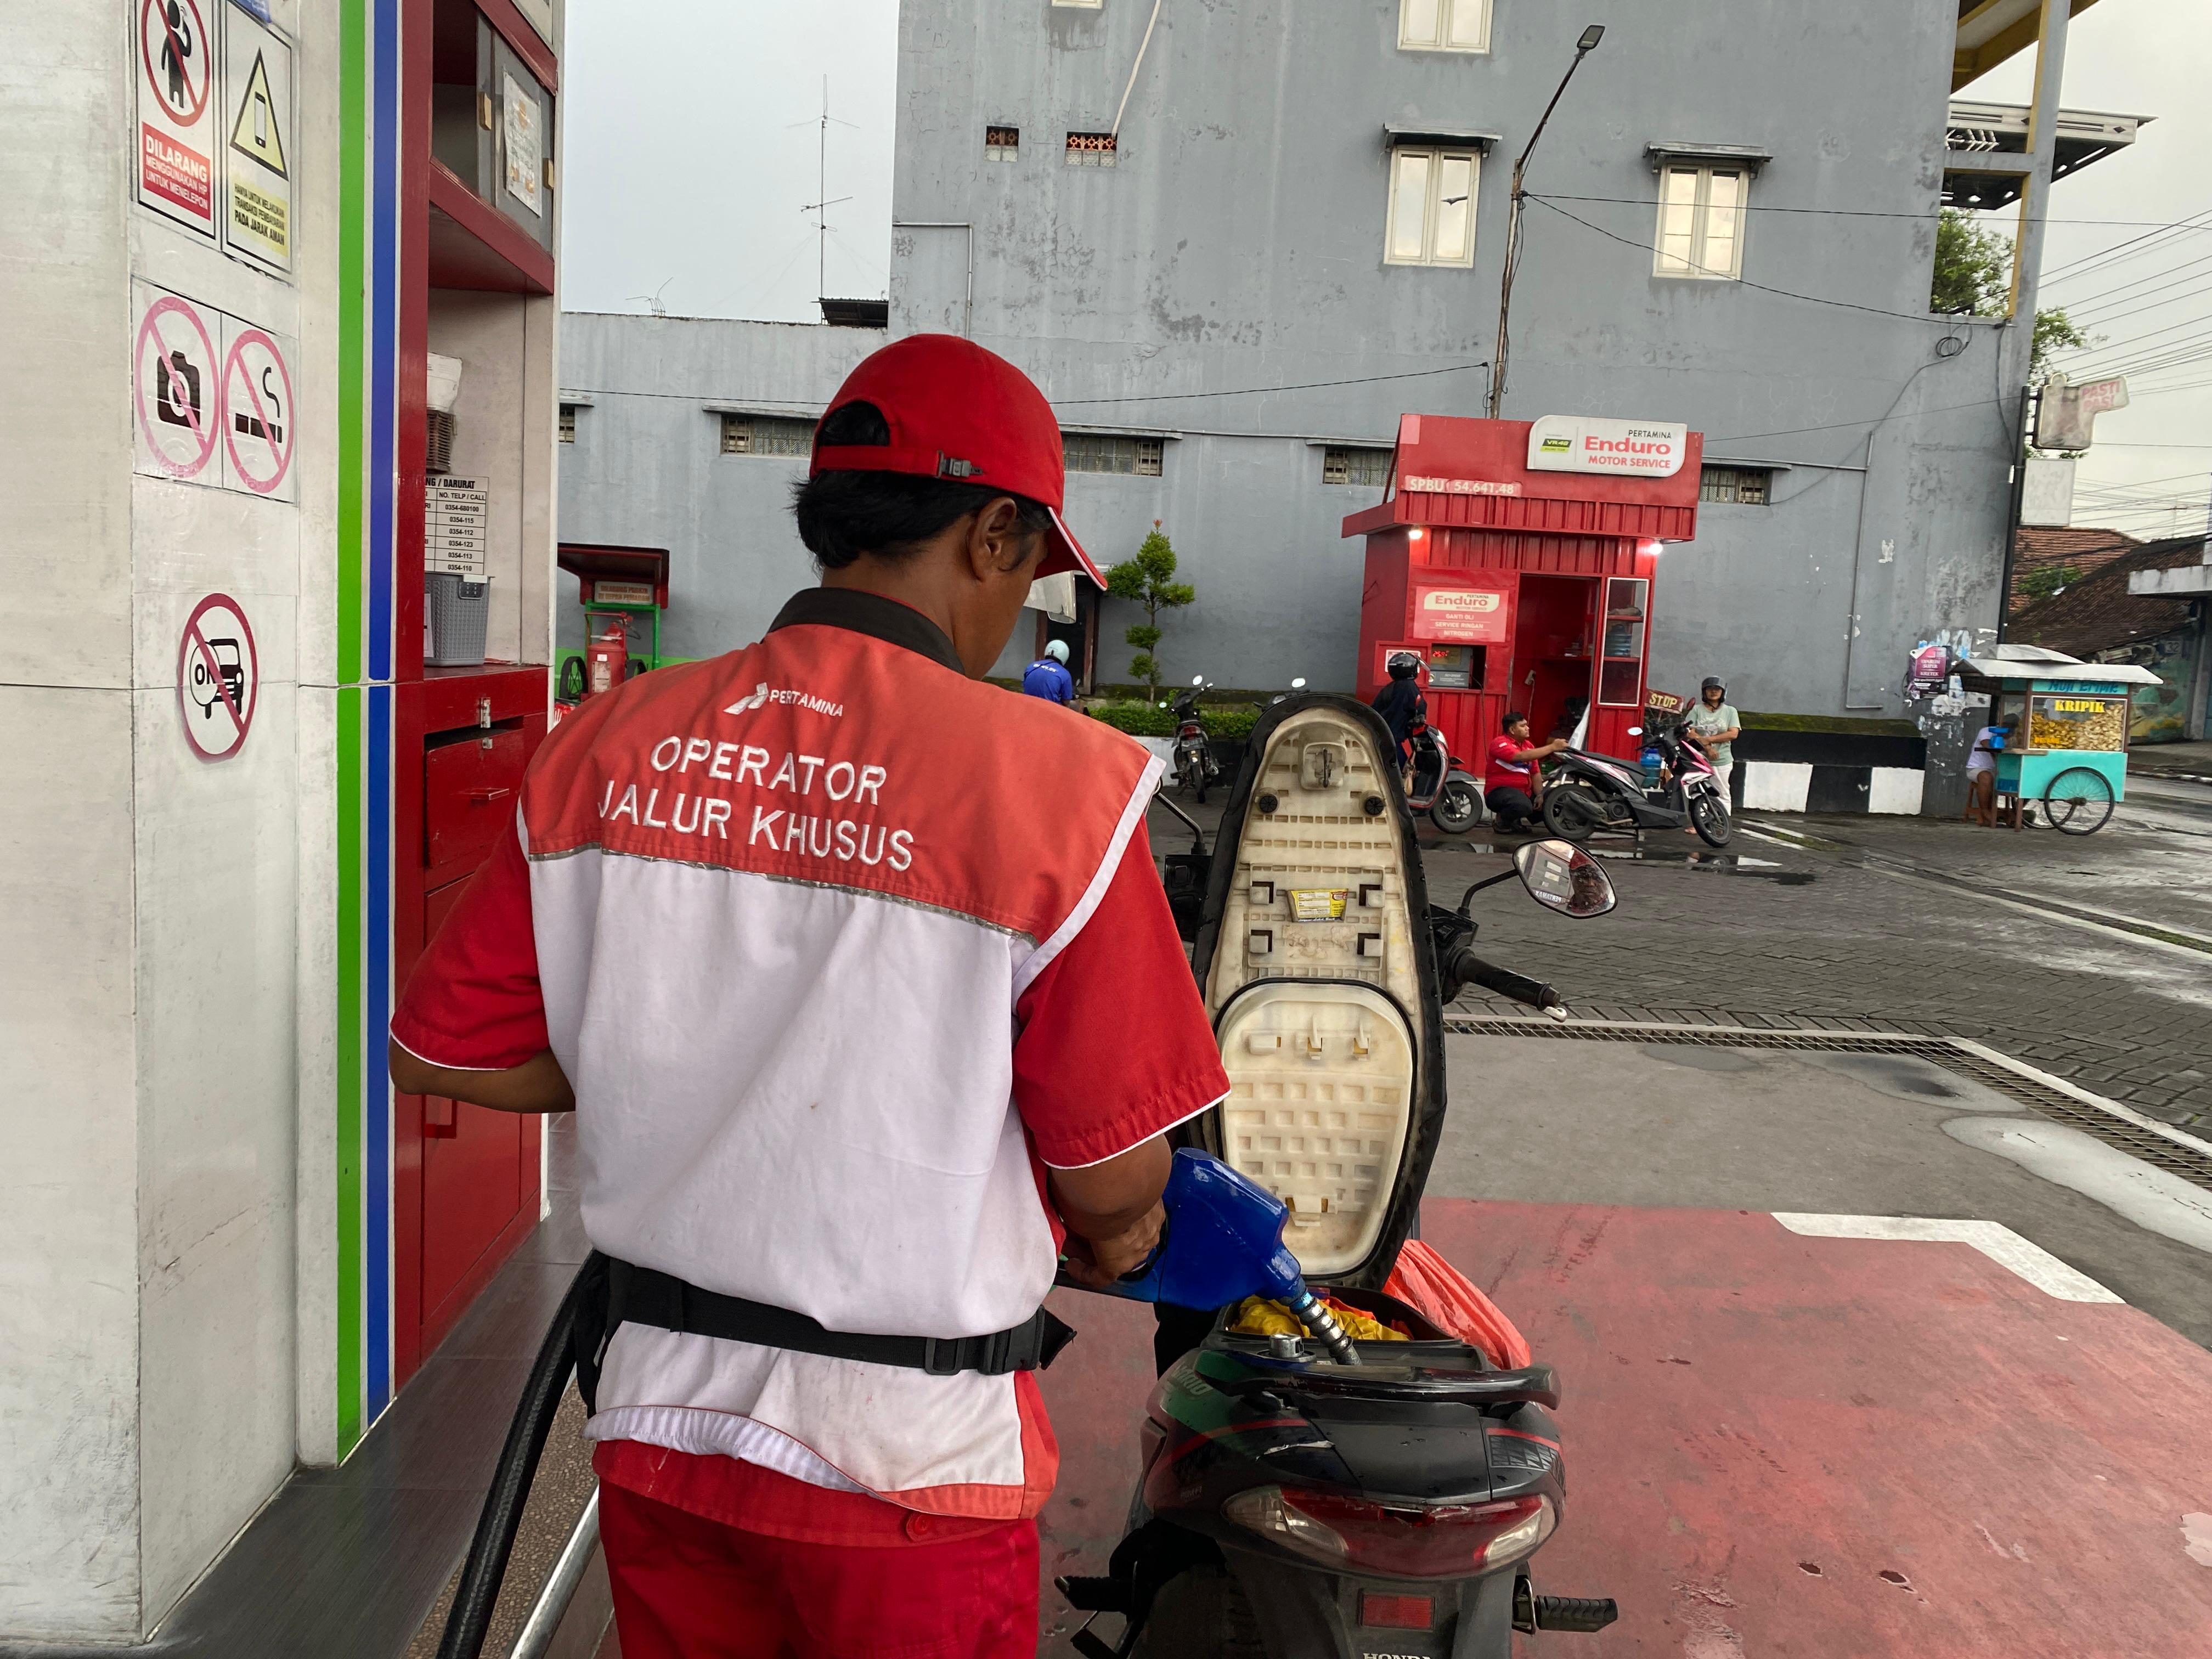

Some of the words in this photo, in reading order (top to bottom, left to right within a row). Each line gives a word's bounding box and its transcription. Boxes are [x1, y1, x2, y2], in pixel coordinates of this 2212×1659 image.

[145, 133, 207, 183] DILARANG
[145, 168, 169, 190] UNTUK
[170, 181, 208, 210] MENELEPON
[250, 218, 268, 238] JARAK
[1628, 430, 1672, 439] PERTAMINA
[1584, 436, 1671, 455] Enduro
[1588, 455, 1627, 466] MOTOR
[1630, 458, 1671, 469] SERVICE
[443, 478, 475, 489] DARURAT
[1409, 478, 1444, 491] SPBU
[1454, 481, 1514, 494] 54.641.48
[1435, 595, 1488, 606] Enduro
[769, 689, 844, 717] PERTAMINA
[1649, 693, 1678, 708] STOP
[2055, 699, 2106, 713] KRIPIK
[650, 735, 887, 805] OPERATOR
[597, 780, 732, 839] JALUR
[748, 805, 914, 872] KHUSUS
